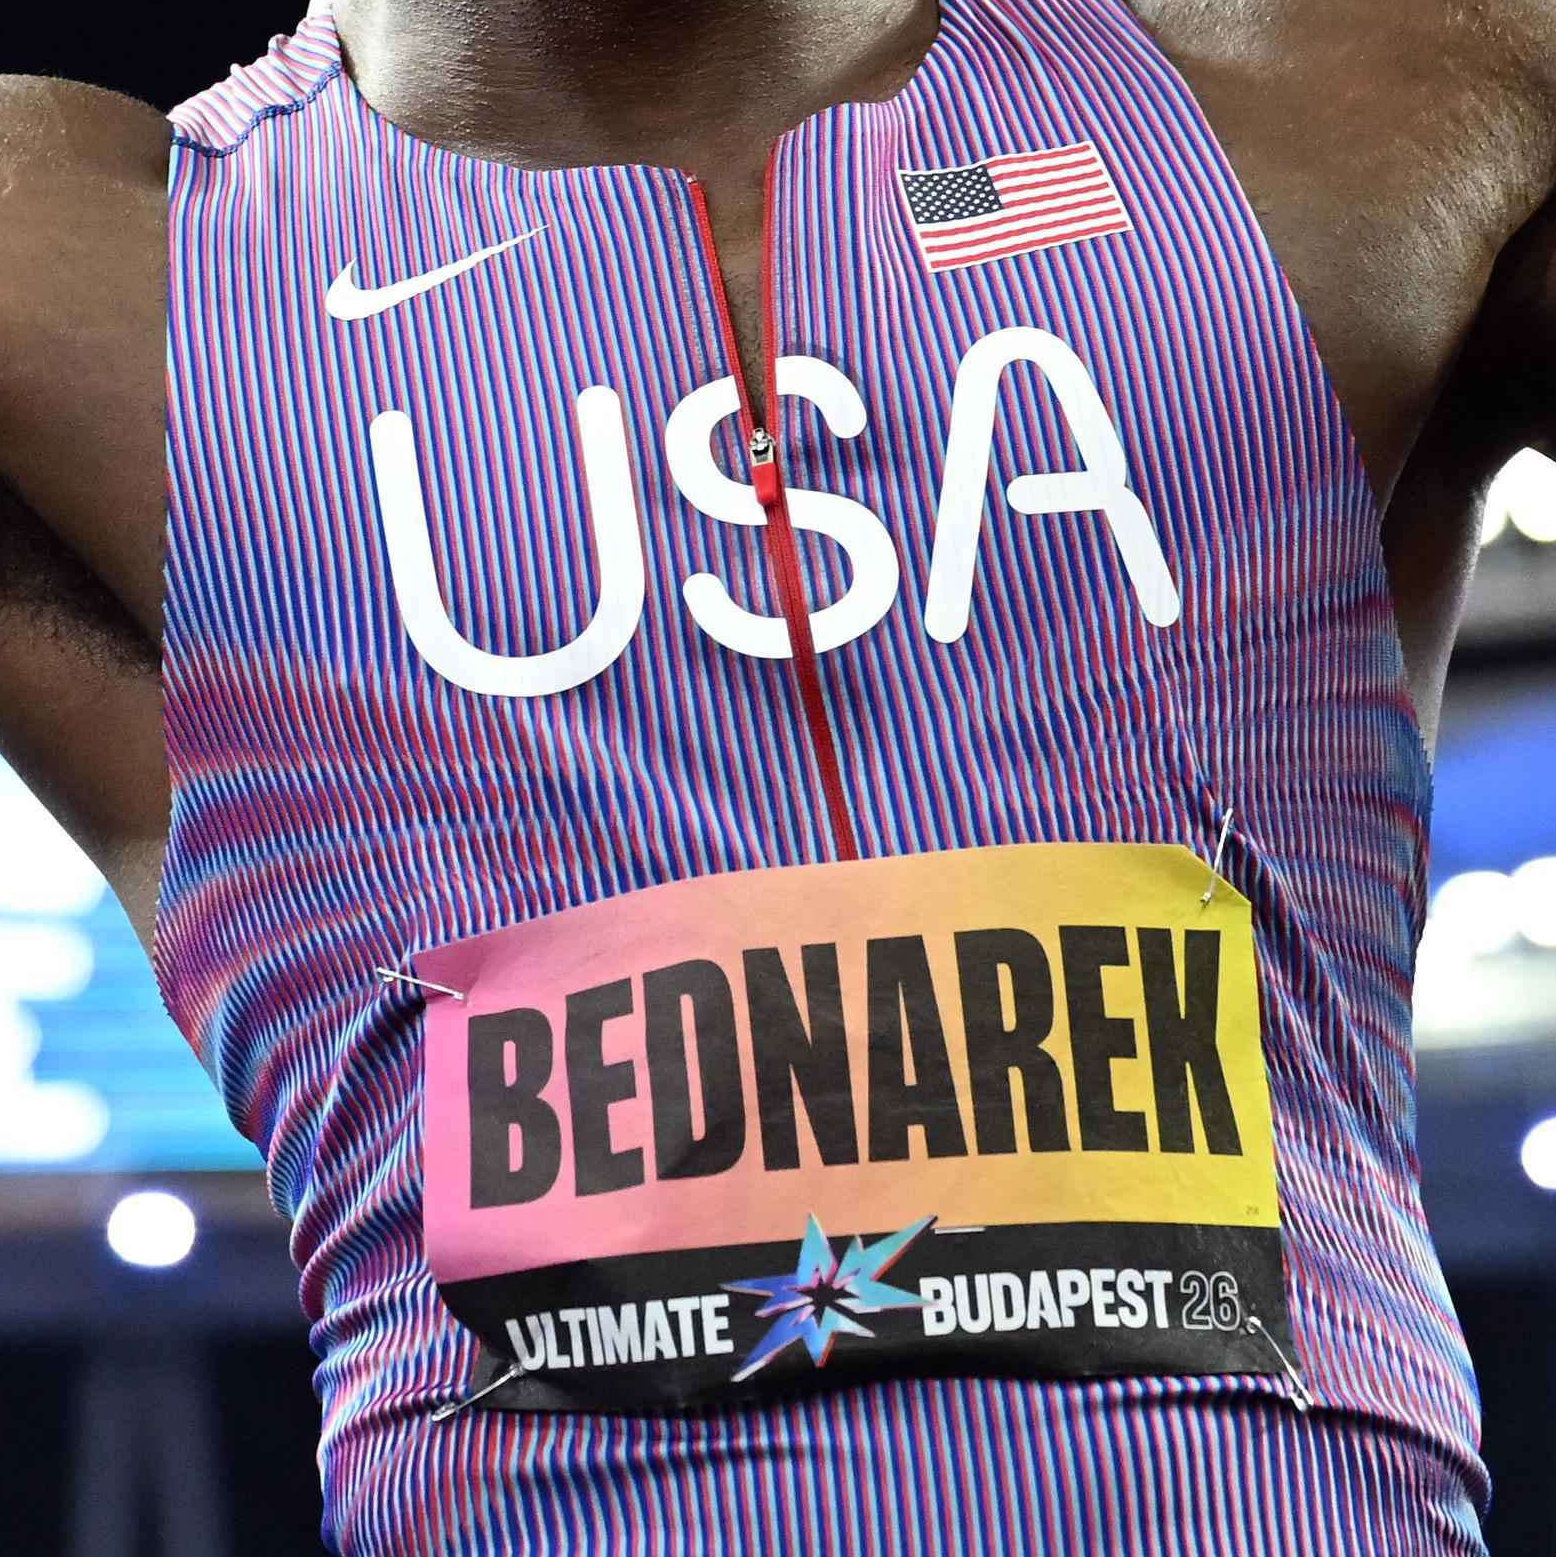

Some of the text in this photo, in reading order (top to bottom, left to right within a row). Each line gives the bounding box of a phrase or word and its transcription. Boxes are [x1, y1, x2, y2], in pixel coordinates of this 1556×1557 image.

[369, 326, 1180, 697] USA
[468, 925, 1244, 1210] BEDNAREK
[505, 1268, 1241, 1371] ULTIMATE BUDAPEST 26
